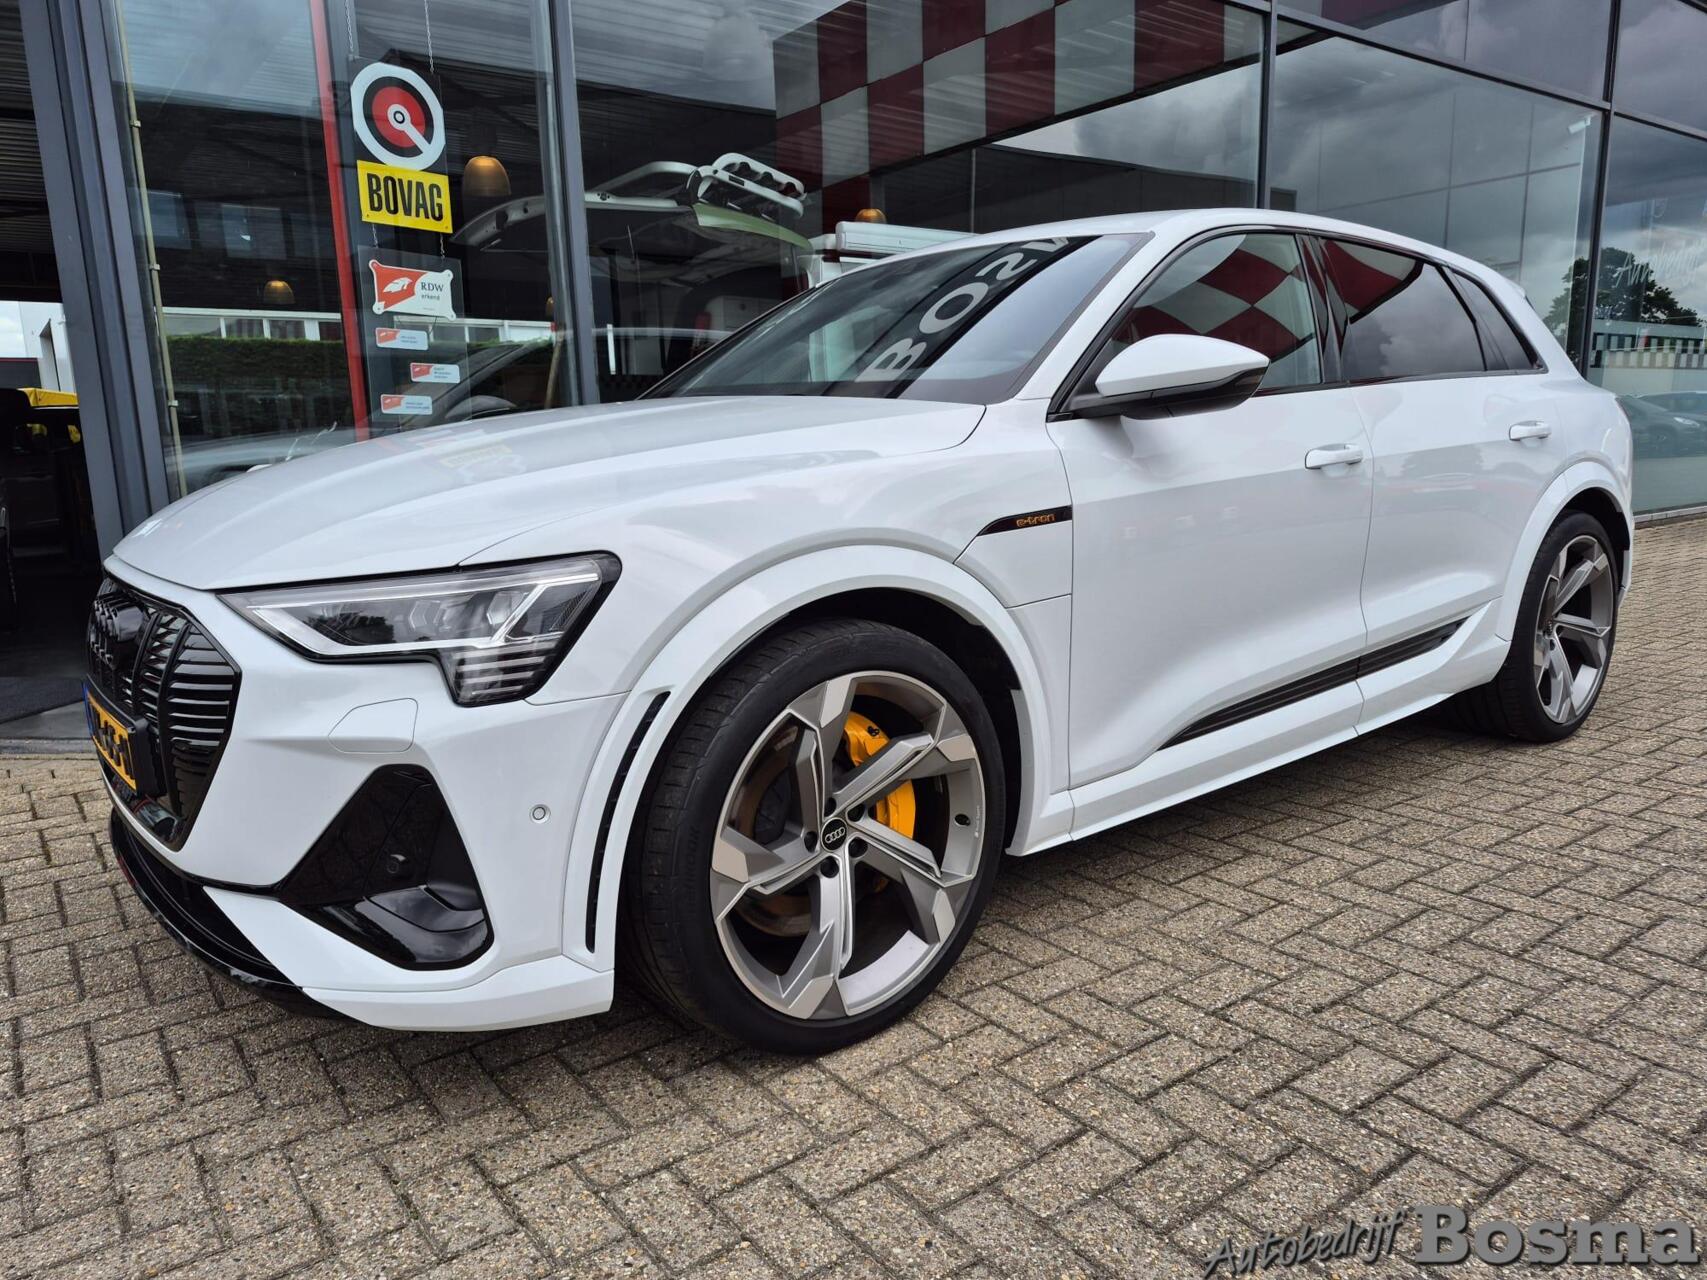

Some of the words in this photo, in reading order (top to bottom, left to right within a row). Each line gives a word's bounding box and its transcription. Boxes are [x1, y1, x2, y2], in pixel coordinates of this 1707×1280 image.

[366, 172, 444, 222] BOVAG
[421, 281, 444, 292] RDW
[1016, 513, 1055, 528] e-tron
